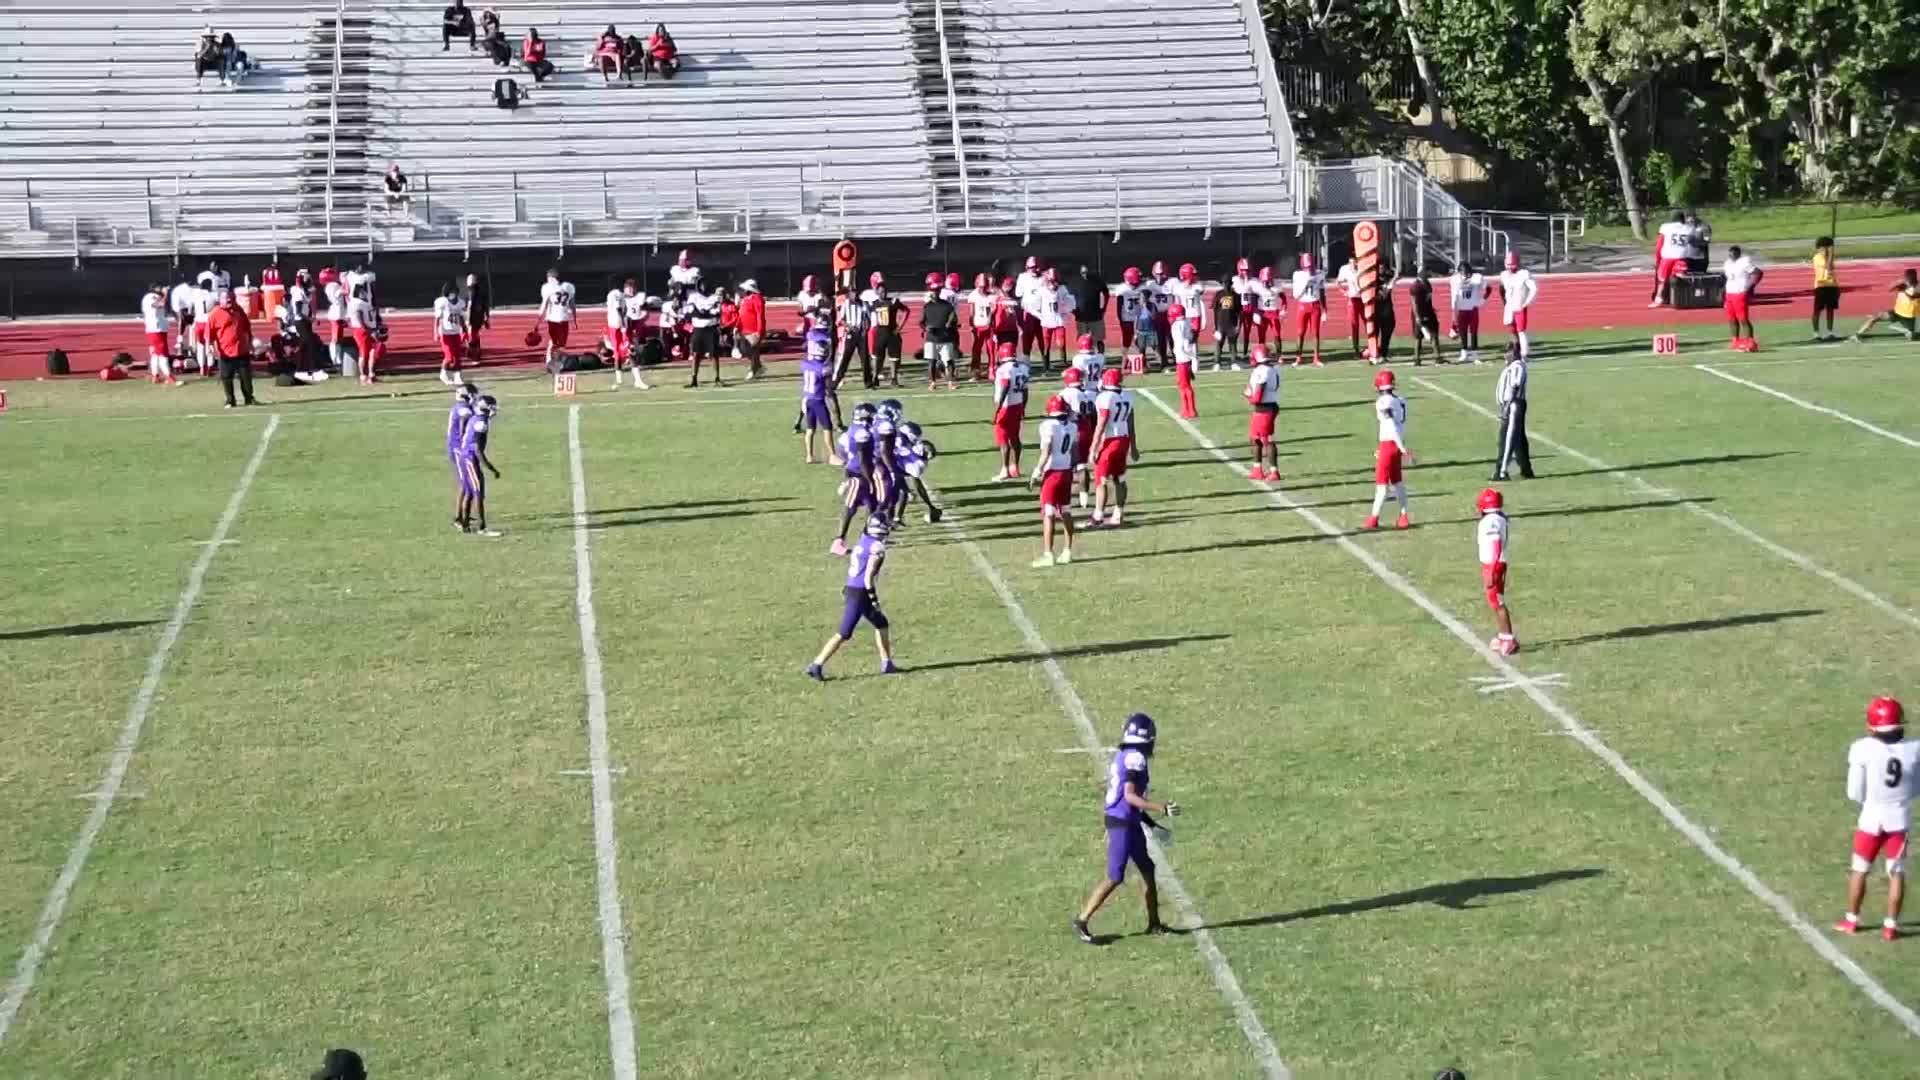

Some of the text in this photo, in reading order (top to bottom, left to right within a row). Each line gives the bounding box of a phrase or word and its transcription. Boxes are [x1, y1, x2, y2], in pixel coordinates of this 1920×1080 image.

[1656, 337, 1674, 353] 30
[1087, 362, 1101, 382] 12
[1124, 356, 1141, 373] 40
[557, 376, 574, 393] 50
[1113, 400, 1131, 423] 77
[1060, 432, 1071, 456] 0
[1885, 757, 1903, 789] 9
